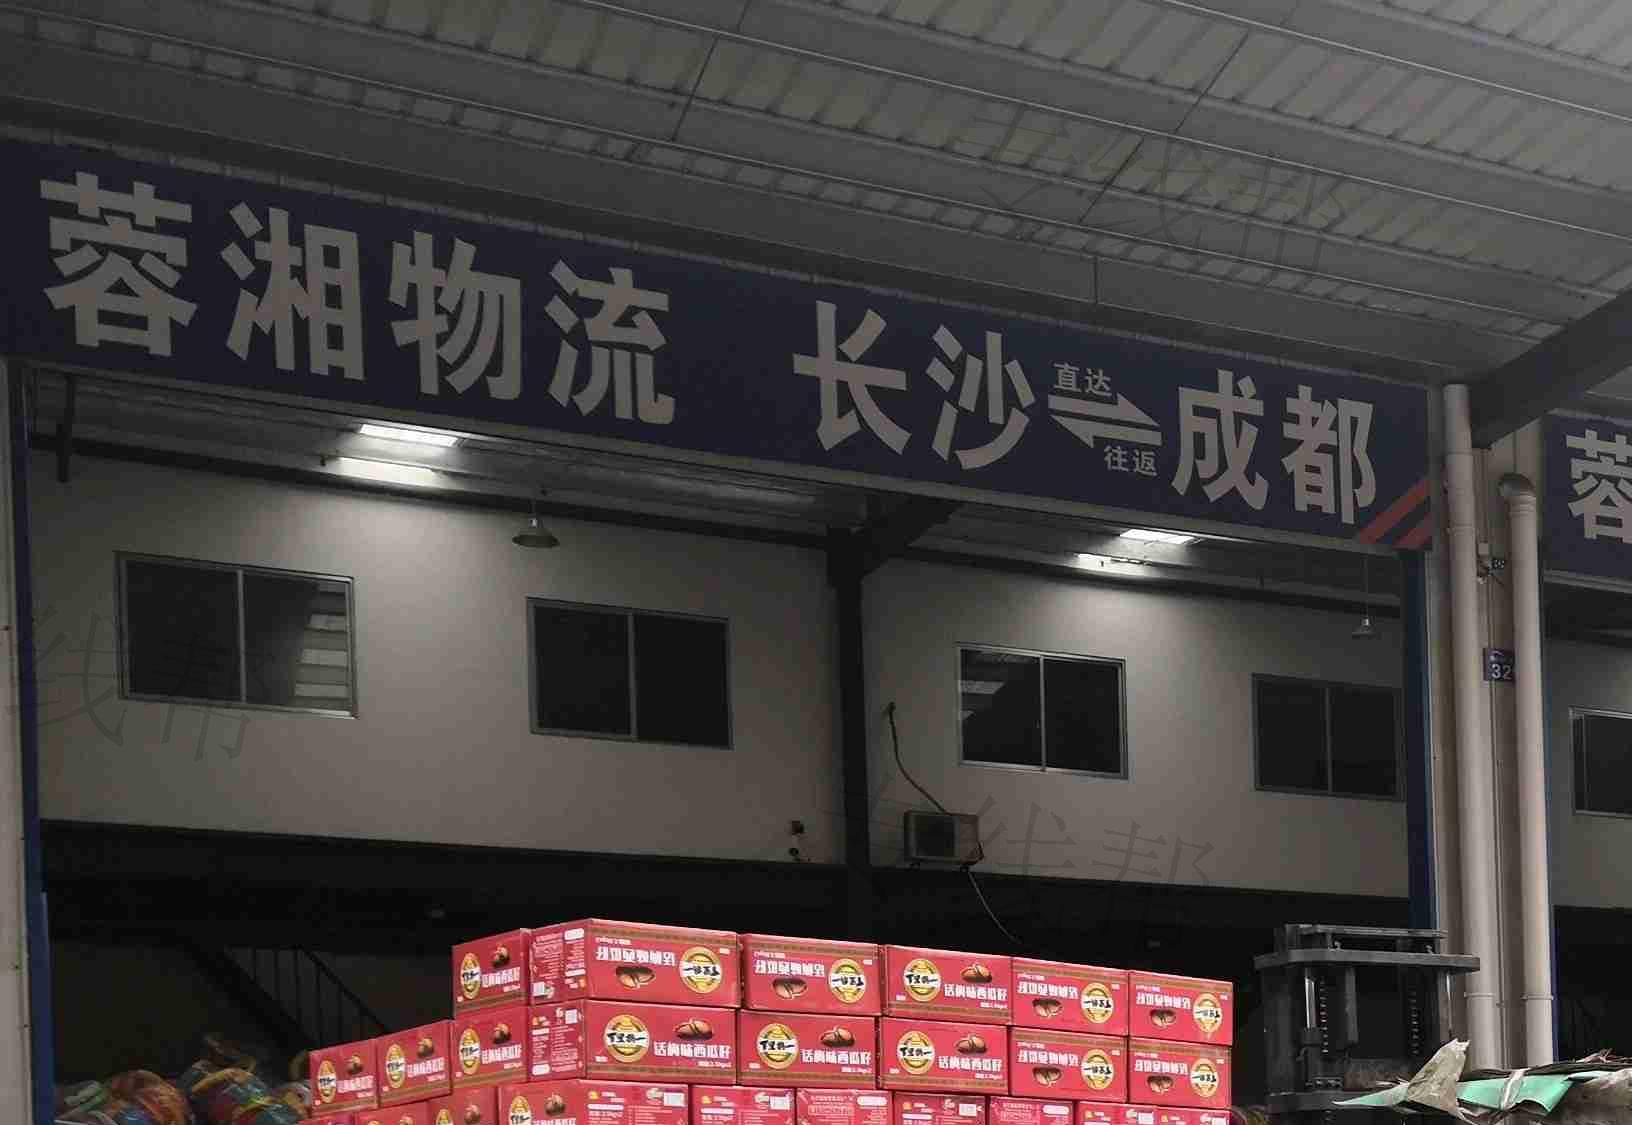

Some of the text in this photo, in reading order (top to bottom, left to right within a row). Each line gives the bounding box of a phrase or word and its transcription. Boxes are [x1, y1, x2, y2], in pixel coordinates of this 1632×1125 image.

[39, 170, 678, 425] 蓉湘物流
[792, 300, 1377, 525] 长沙 成都
[1053, 361, 1114, 398] 直达
[1103, 445, 1160, 478] 往返
